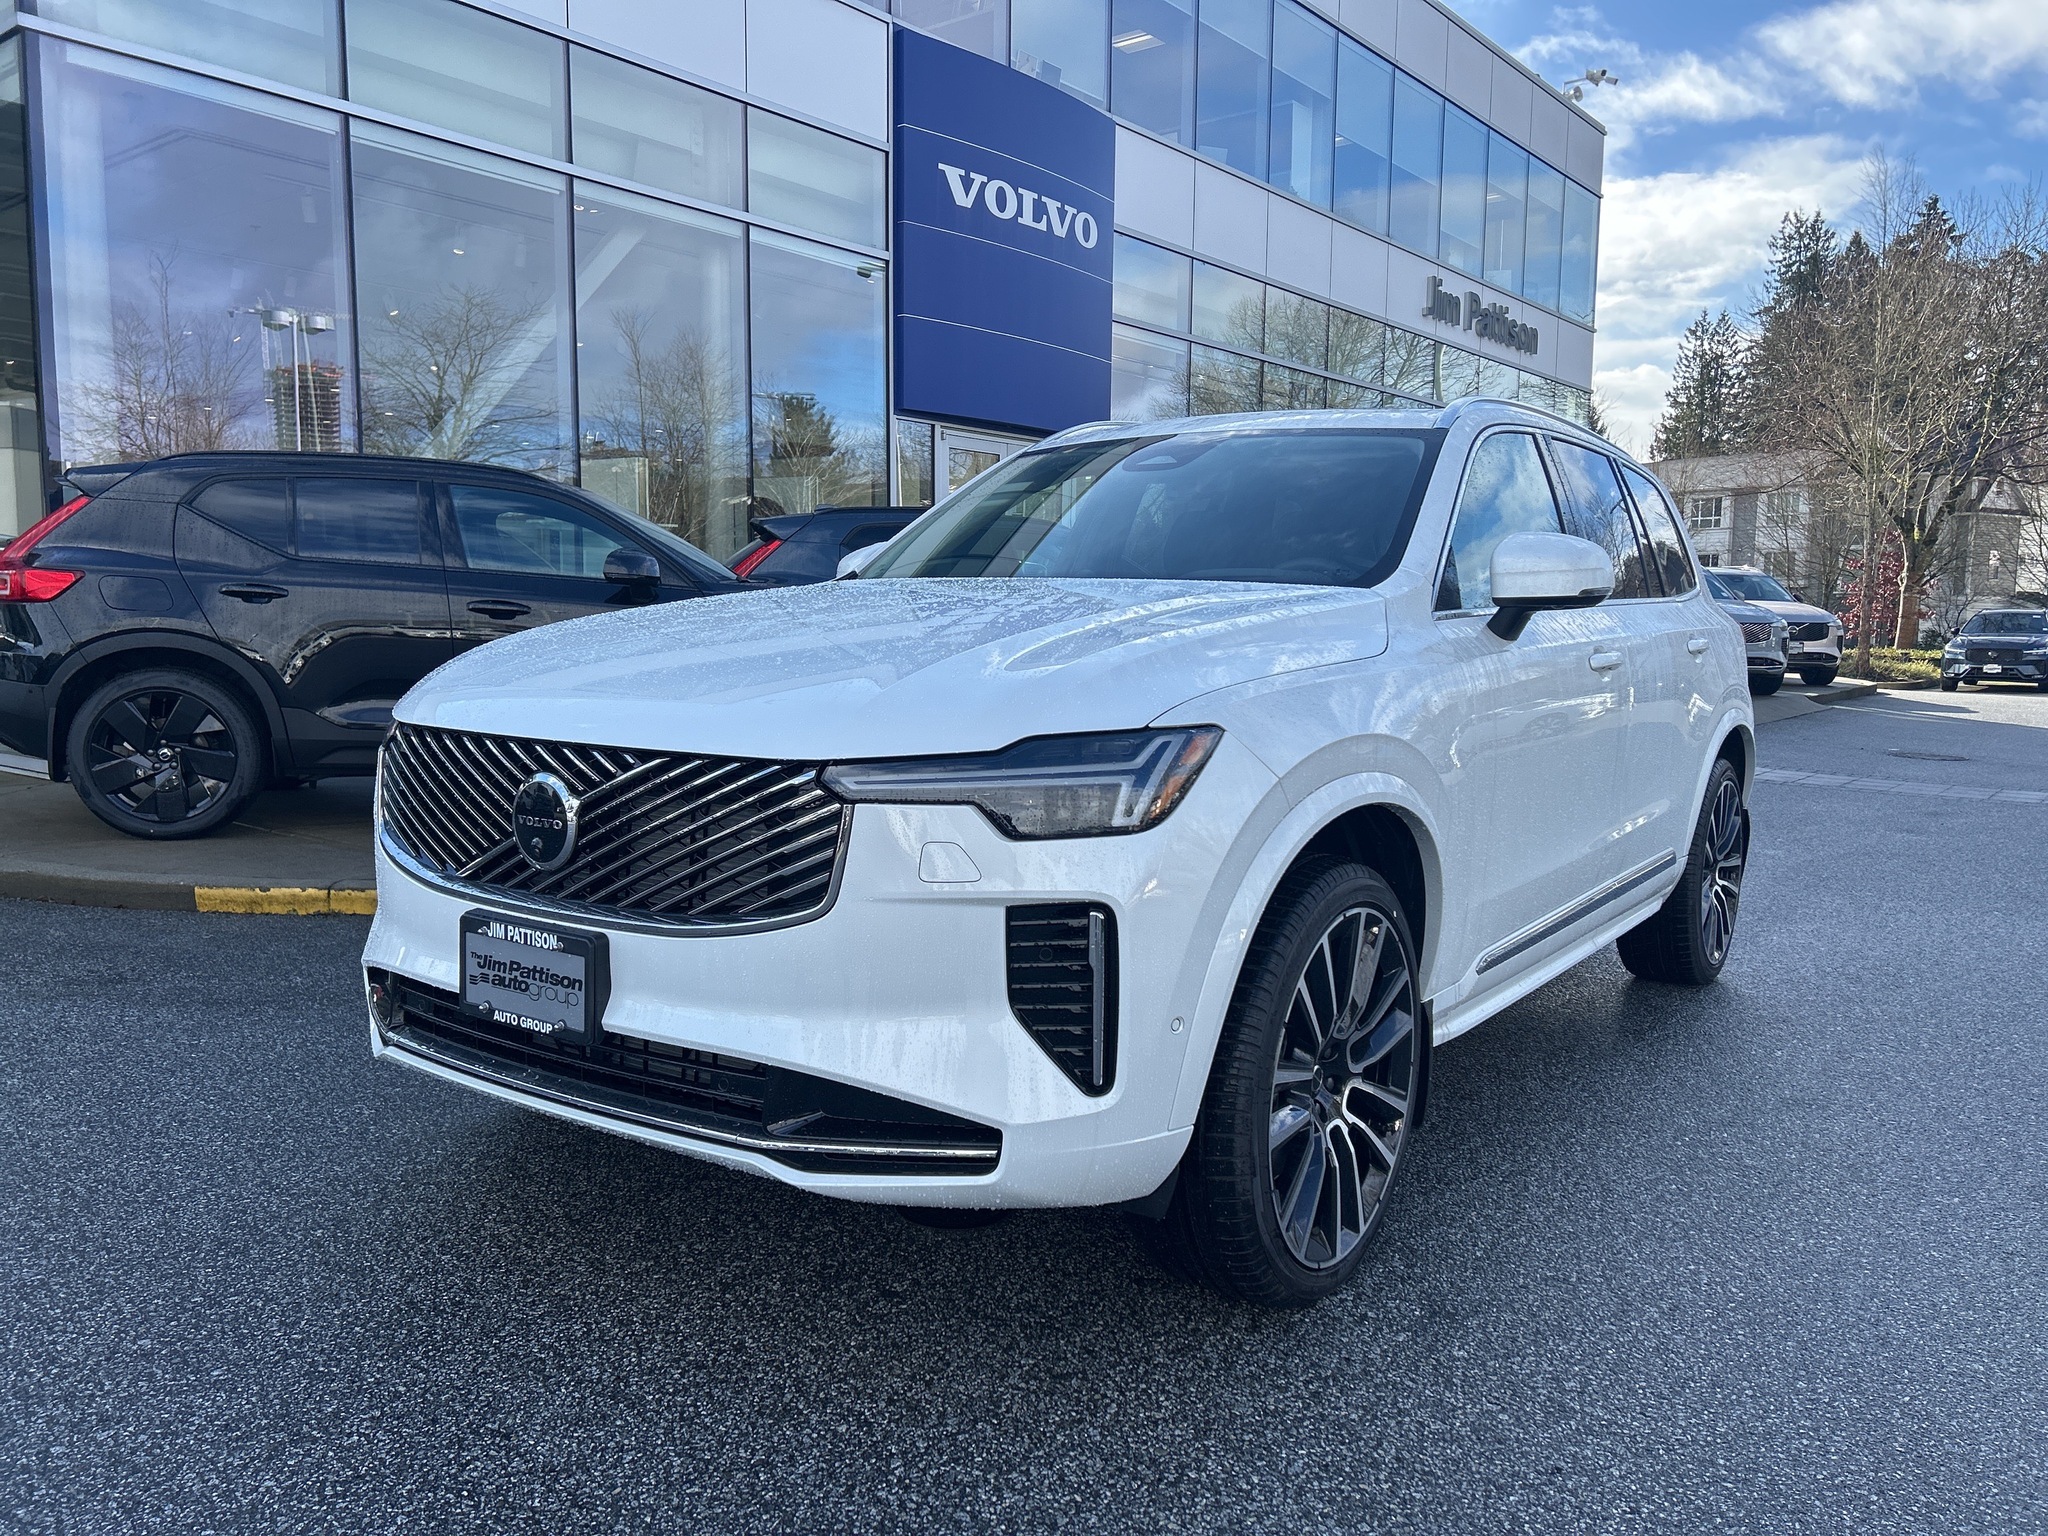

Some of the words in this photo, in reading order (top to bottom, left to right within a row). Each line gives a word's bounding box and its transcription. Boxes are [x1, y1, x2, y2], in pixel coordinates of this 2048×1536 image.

[938, 162, 1098, 249] VOLVO
[1422, 275, 1461, 327] Jim
[1463, 291, 1539, 355] Pattison
[517, 814, 563, 830] VOLVO
[487, 921, 505, 939] JIM
[507, 924, 558, 950] PATTISON
[470, 951, 483, 960] The
[493, 1010, 518, 1026] AUTO
[519, 1016, 553, 1035] GROUP
